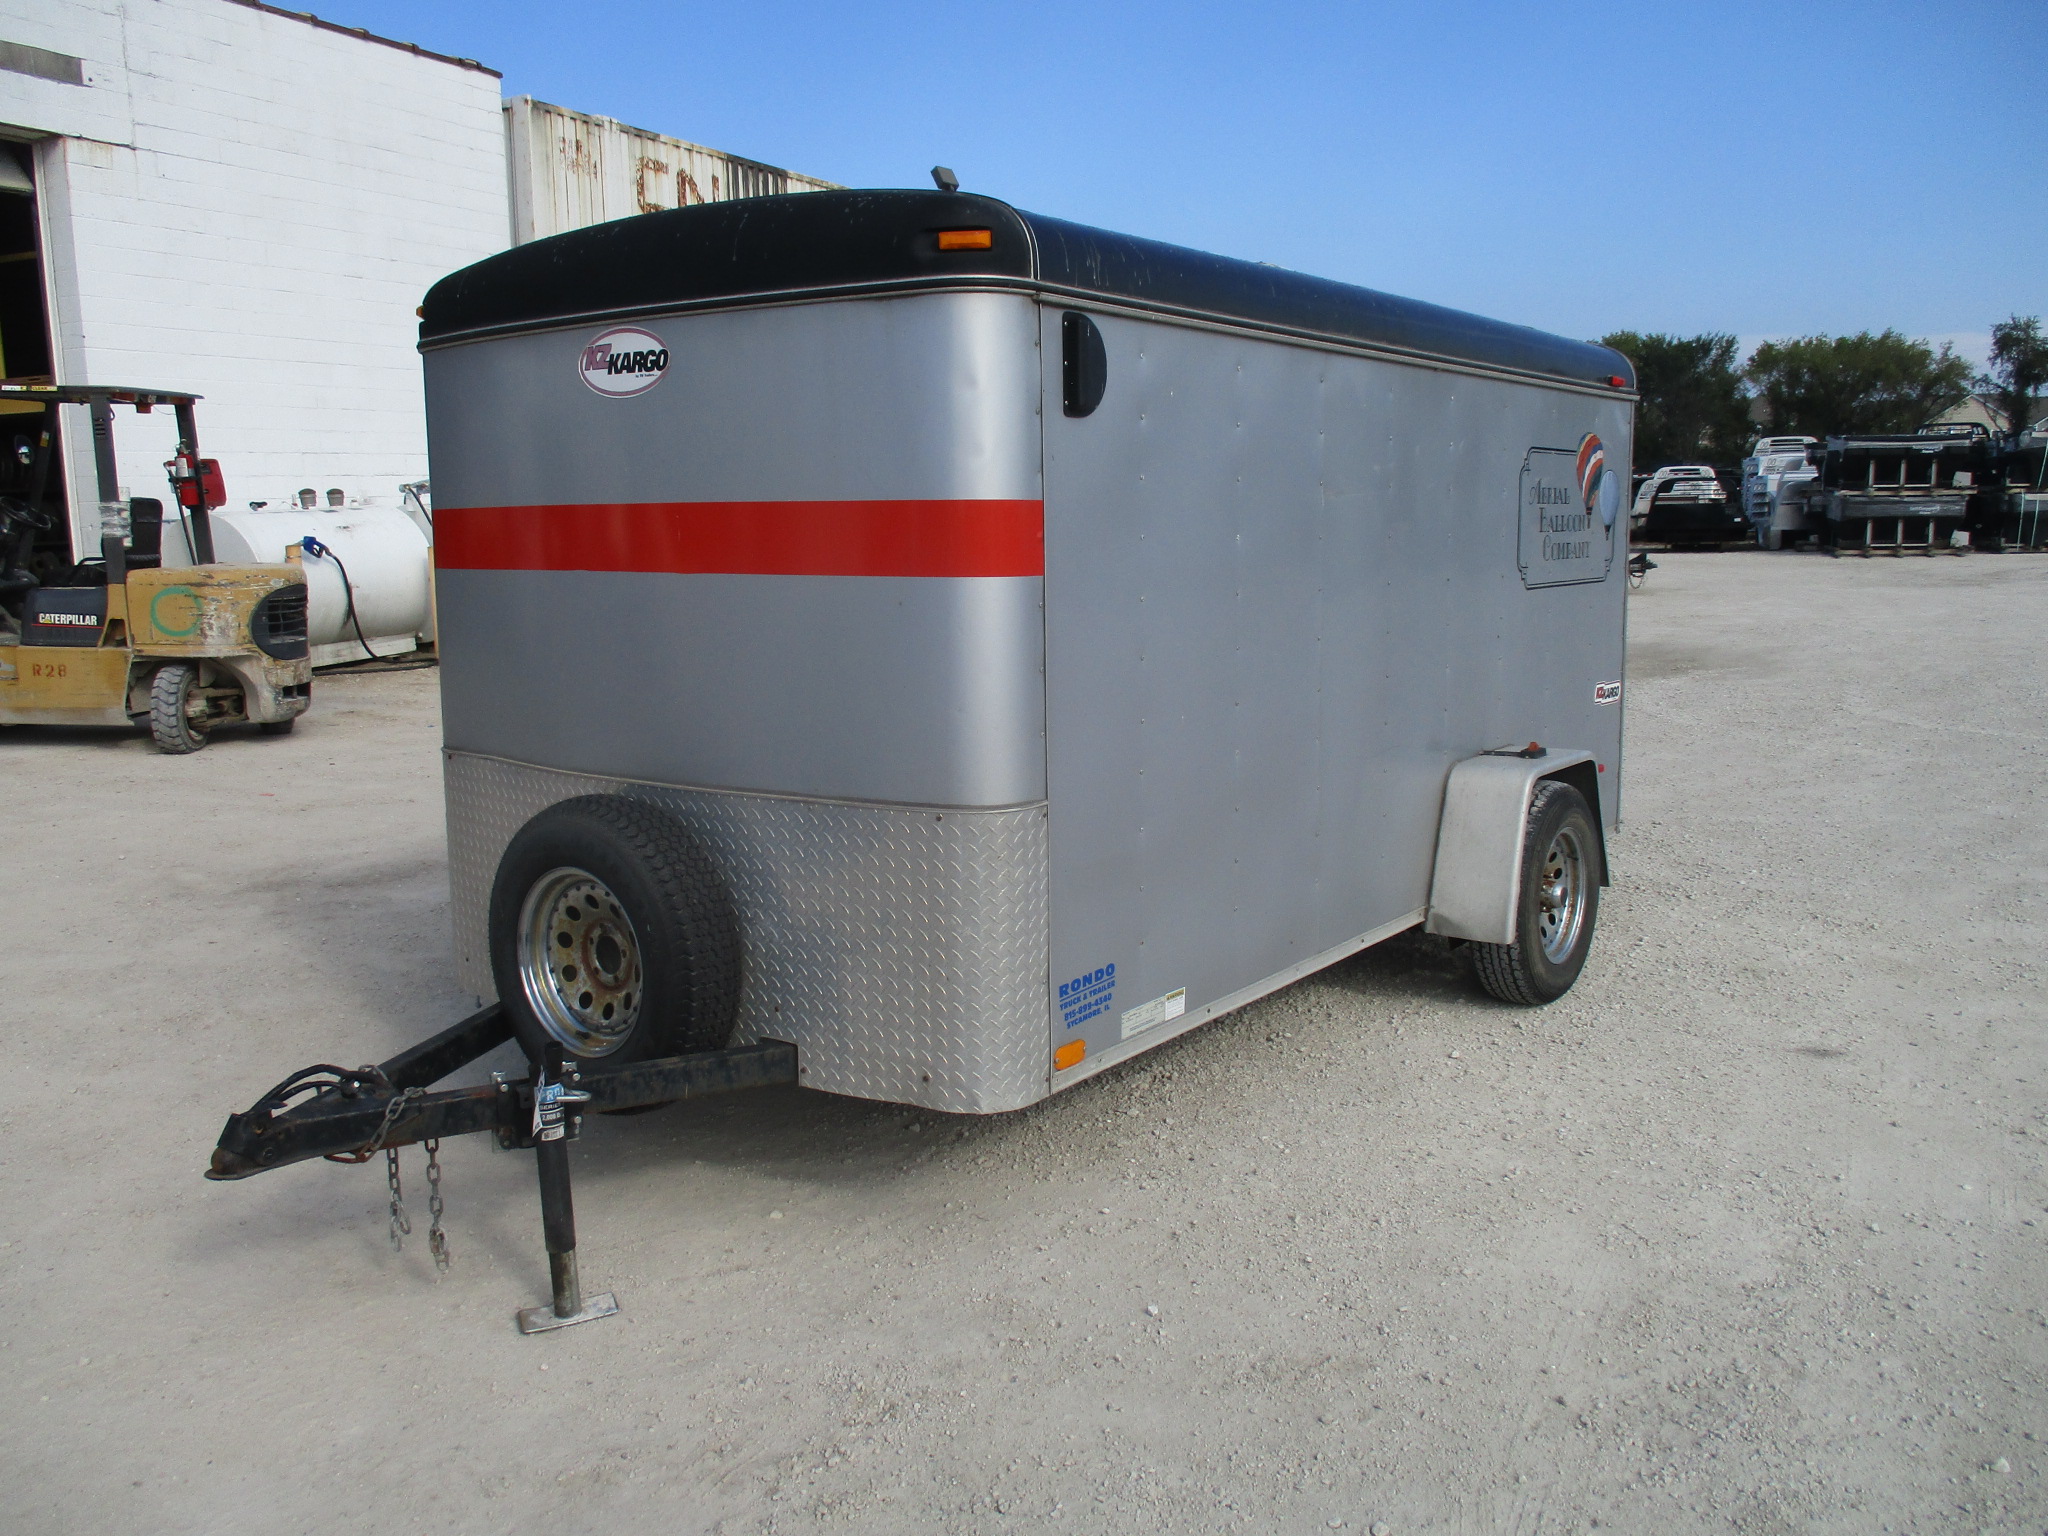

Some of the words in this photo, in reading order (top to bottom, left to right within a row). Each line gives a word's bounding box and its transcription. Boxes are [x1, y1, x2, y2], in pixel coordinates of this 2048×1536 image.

[39, 612, 97, 626] CATERPILLAR
[1058, 962, 1115, 998] RONDO
[1059, 994, 1081, 1011] TRUCK
[1083, 992, 1088, 1001] &
[1088, 979, 1115, 998] TRAILER
[1104, 1003, 1110, 1011] IL
